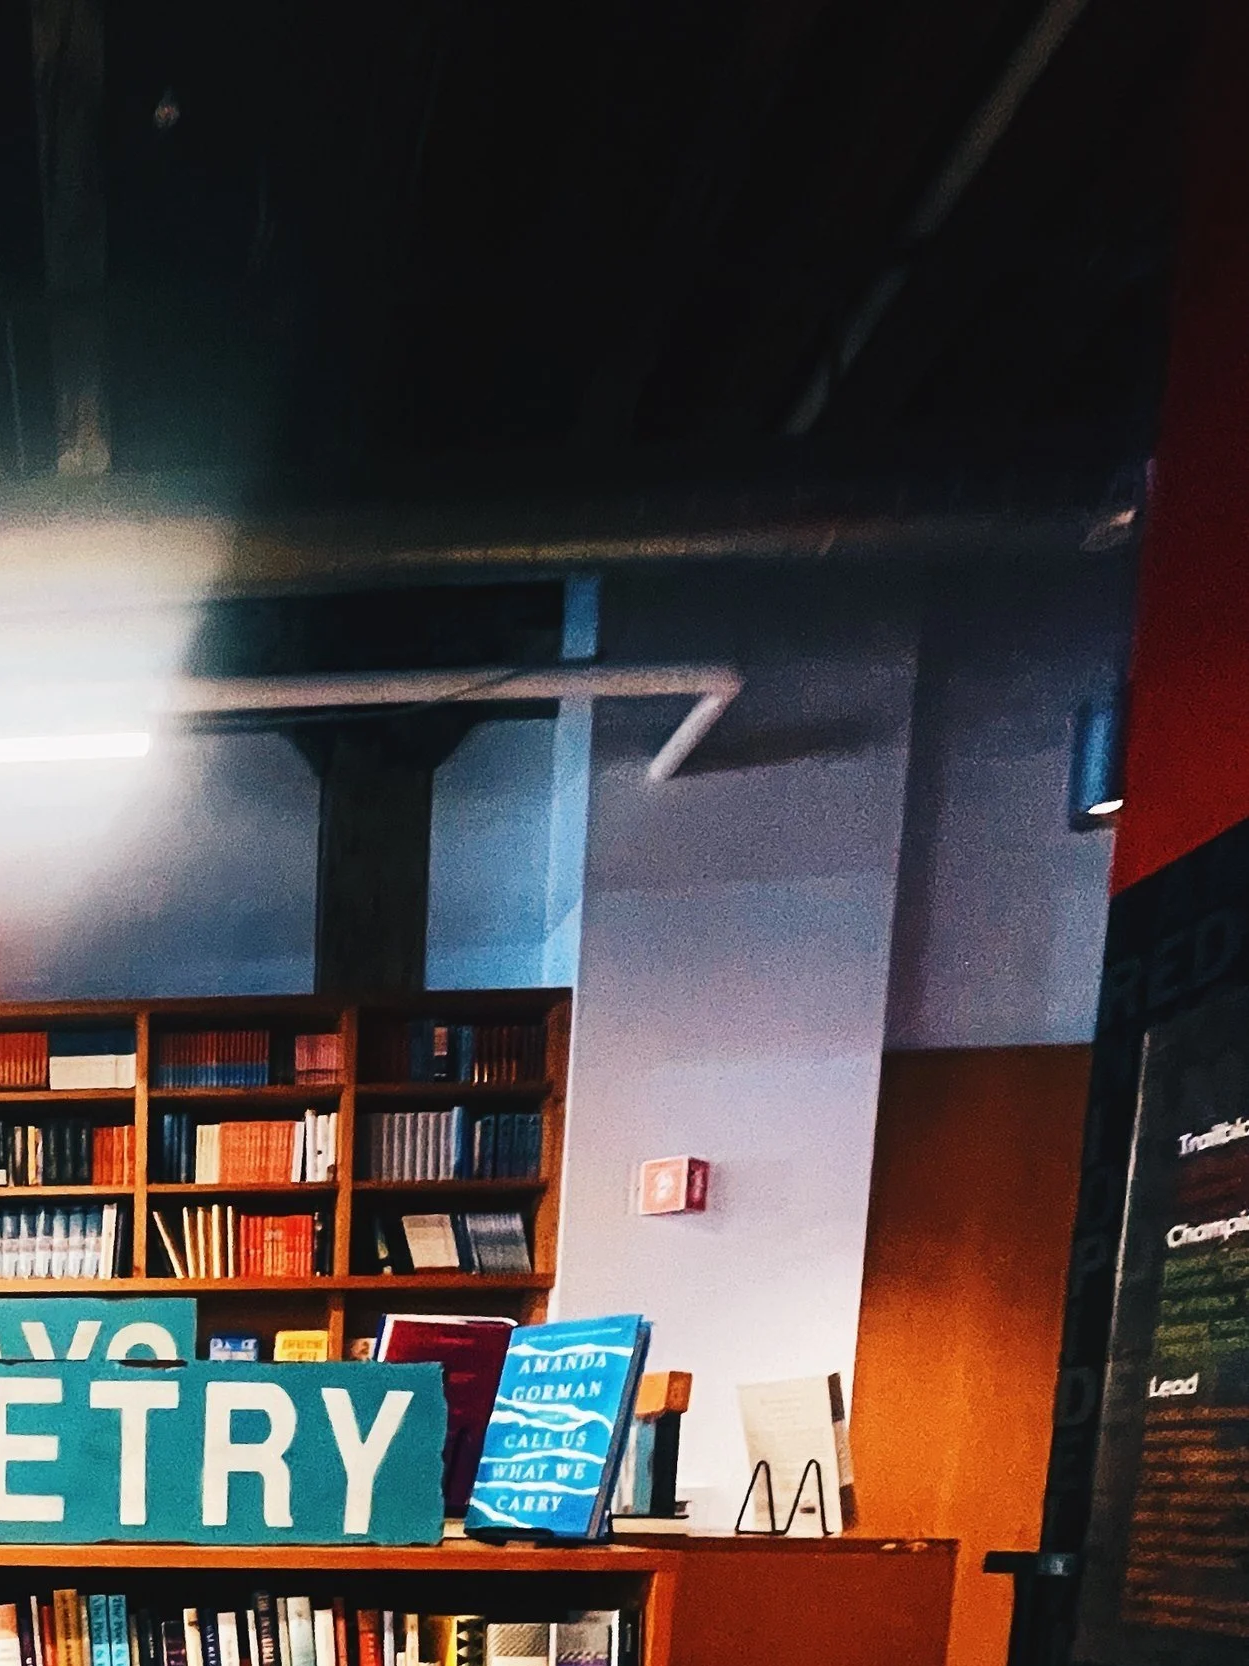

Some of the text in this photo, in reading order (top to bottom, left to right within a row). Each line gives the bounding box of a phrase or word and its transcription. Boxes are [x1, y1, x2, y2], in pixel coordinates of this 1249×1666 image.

[1165, 1209, 1249, 1248] Champi
[518, 1352, 608, 1375] AMANDA
[511, 1381, 602, 1402] GORMAN
[1147, 1372, 1199, 1399] Lead
[504, 1431, 587, 1449] CALL US
[492, 1463, 586, 1481] WHAT WE
[495, 1495, 562, 1512] CARRY
